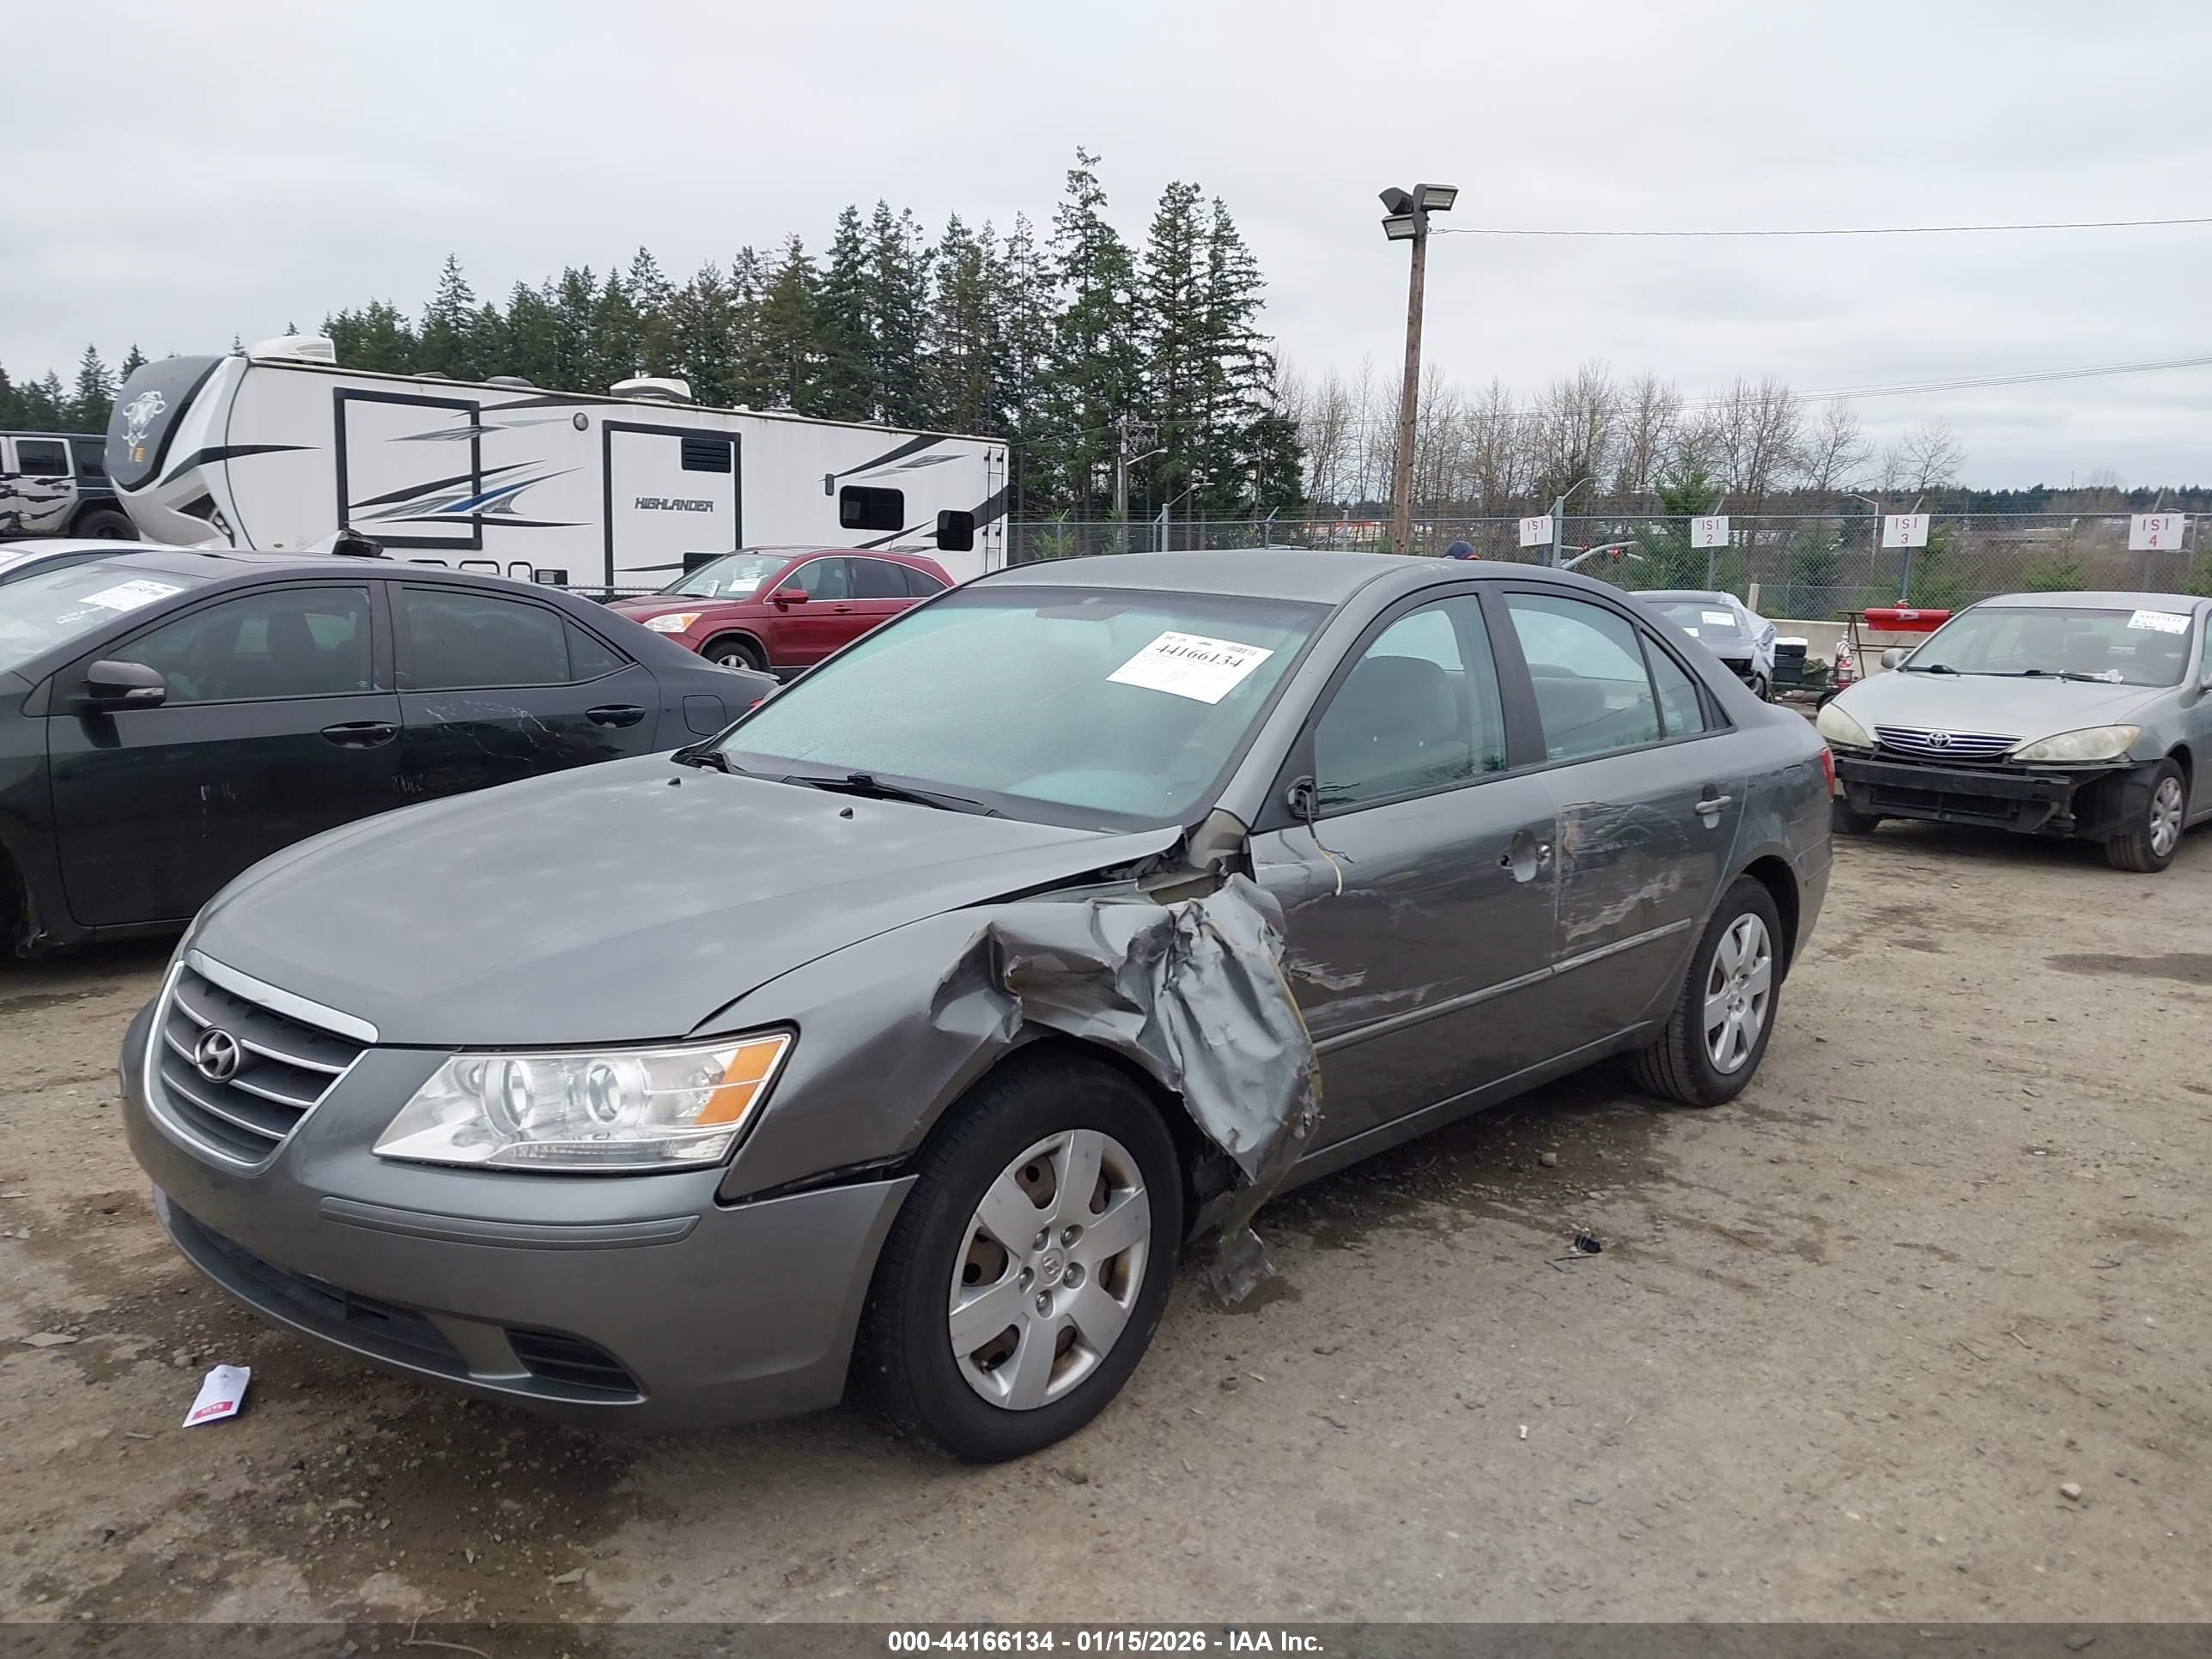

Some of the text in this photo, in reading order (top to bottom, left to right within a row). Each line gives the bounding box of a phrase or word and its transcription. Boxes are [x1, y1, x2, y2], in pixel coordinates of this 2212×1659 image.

[635, 497, 714, 513] HIGHLANDER
[1706, 533, 1713, 544] 2
[1901, 532, 1909, 544] 3
[2149, 534, 2158, 547] 4
[1156, 644, 1245, 668] 44166134
